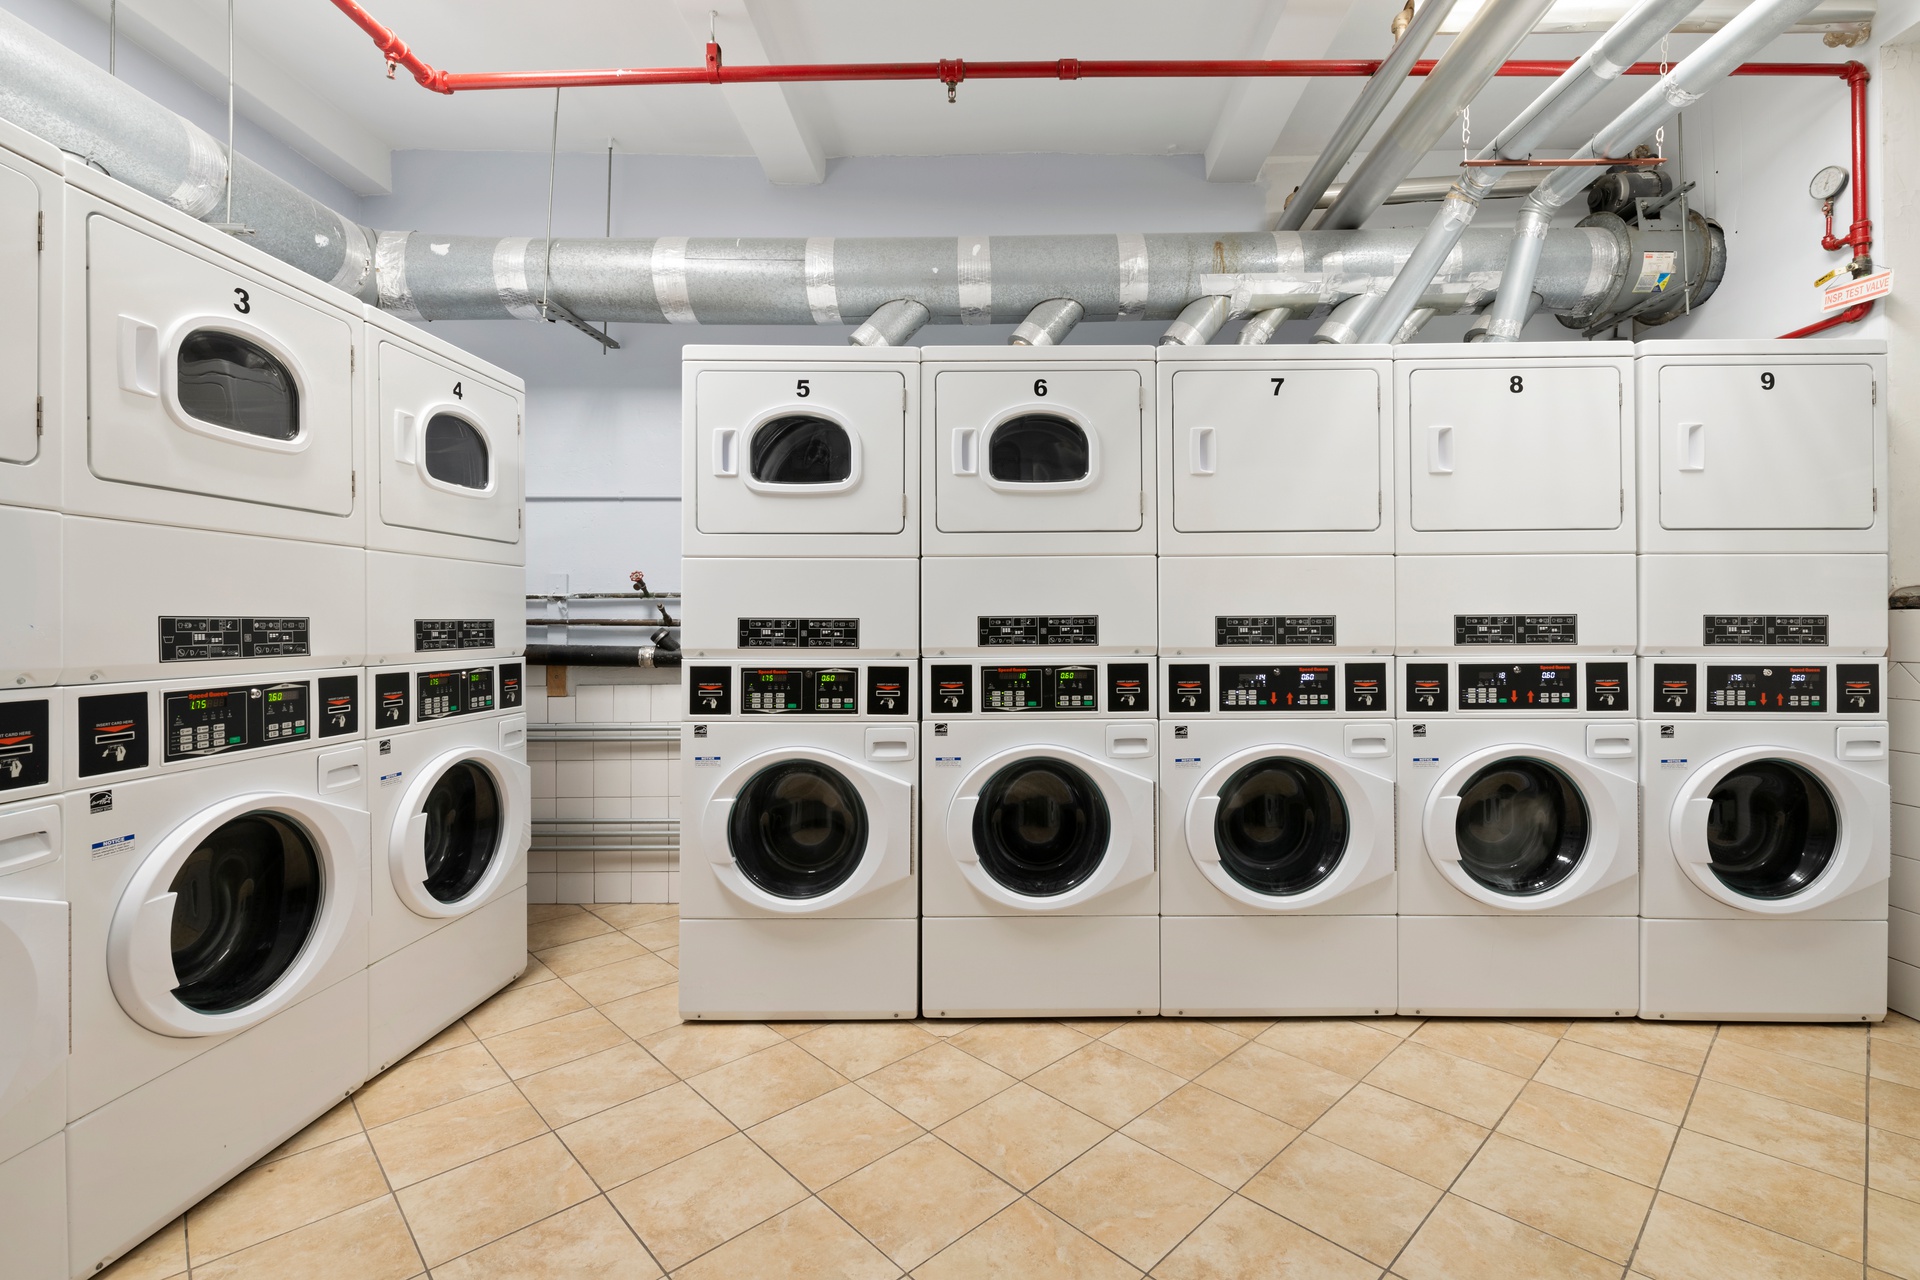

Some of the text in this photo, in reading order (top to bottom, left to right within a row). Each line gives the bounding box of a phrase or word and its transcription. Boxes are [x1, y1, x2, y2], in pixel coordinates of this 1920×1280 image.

[1824, 277, 1890, 304] INSP. TEST VALVE
[233, 288, 251, 315] 3
[452, 381, 463, 400] 4
[796, 379, 810, 398] 5
[1033, 379, 1048, 397] 6
[1270, 378, 1285, 396] 7
[1509, 376, 1523, 394] 8
[1760, 372, 1775, 391] 9
[103, 836, 124, 846] NOTICE
